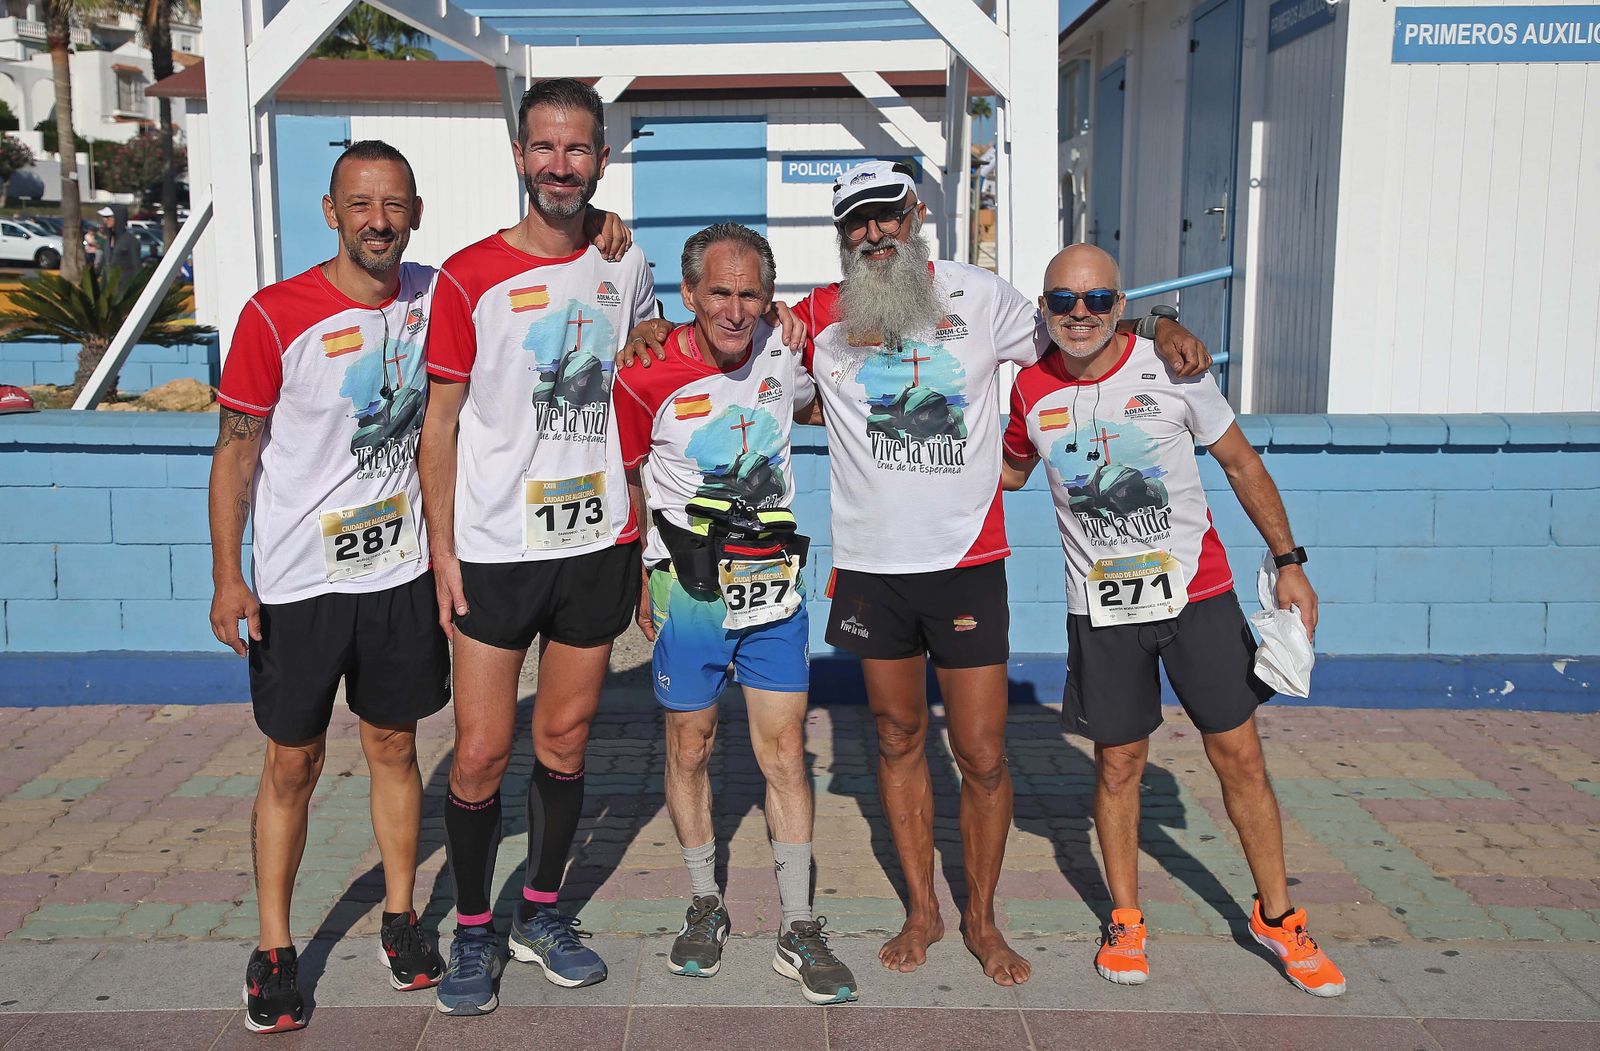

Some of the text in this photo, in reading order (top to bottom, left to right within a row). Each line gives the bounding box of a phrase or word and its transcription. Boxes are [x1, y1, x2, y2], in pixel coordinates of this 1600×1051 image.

[1405, 22, 1518, 45] PRIMEROS
[789, 162, 842, 176] POLICIA
[562, 401, 578, 433] la
[581, 402, 607, 435] vid
[871, 432, 966, 466] Vive la vida
[877, 461, 962, 475] Cruz de la Esperanza
[543, 495, 565, 503] CIUDAD
[341, 522, 364, 533] CIUDAD
[364, 520, 372, 528] DE
[371, 511, 398, 526] ALGECIRAS
[534, 497, 603, 532] 173
[1075, 506, 1172, 539] Vive la vida
[334, 517, 404, 562] 287
[1090, 539, 1108, 547] Cruz
[1109, 537, 1119, 547] de
[1120, 535, 1129, 545] la
[758, 572, 784, 581] ALGECIRAS
[1104, 572, 1124, 580] CIUDAD
[1124, 570, 1133, 578] DE
[1132, 565, 1163, 577] ALGECIRAS
[726, 580, 790, 611] 327
[1098, 573, 1173, 607] 271
